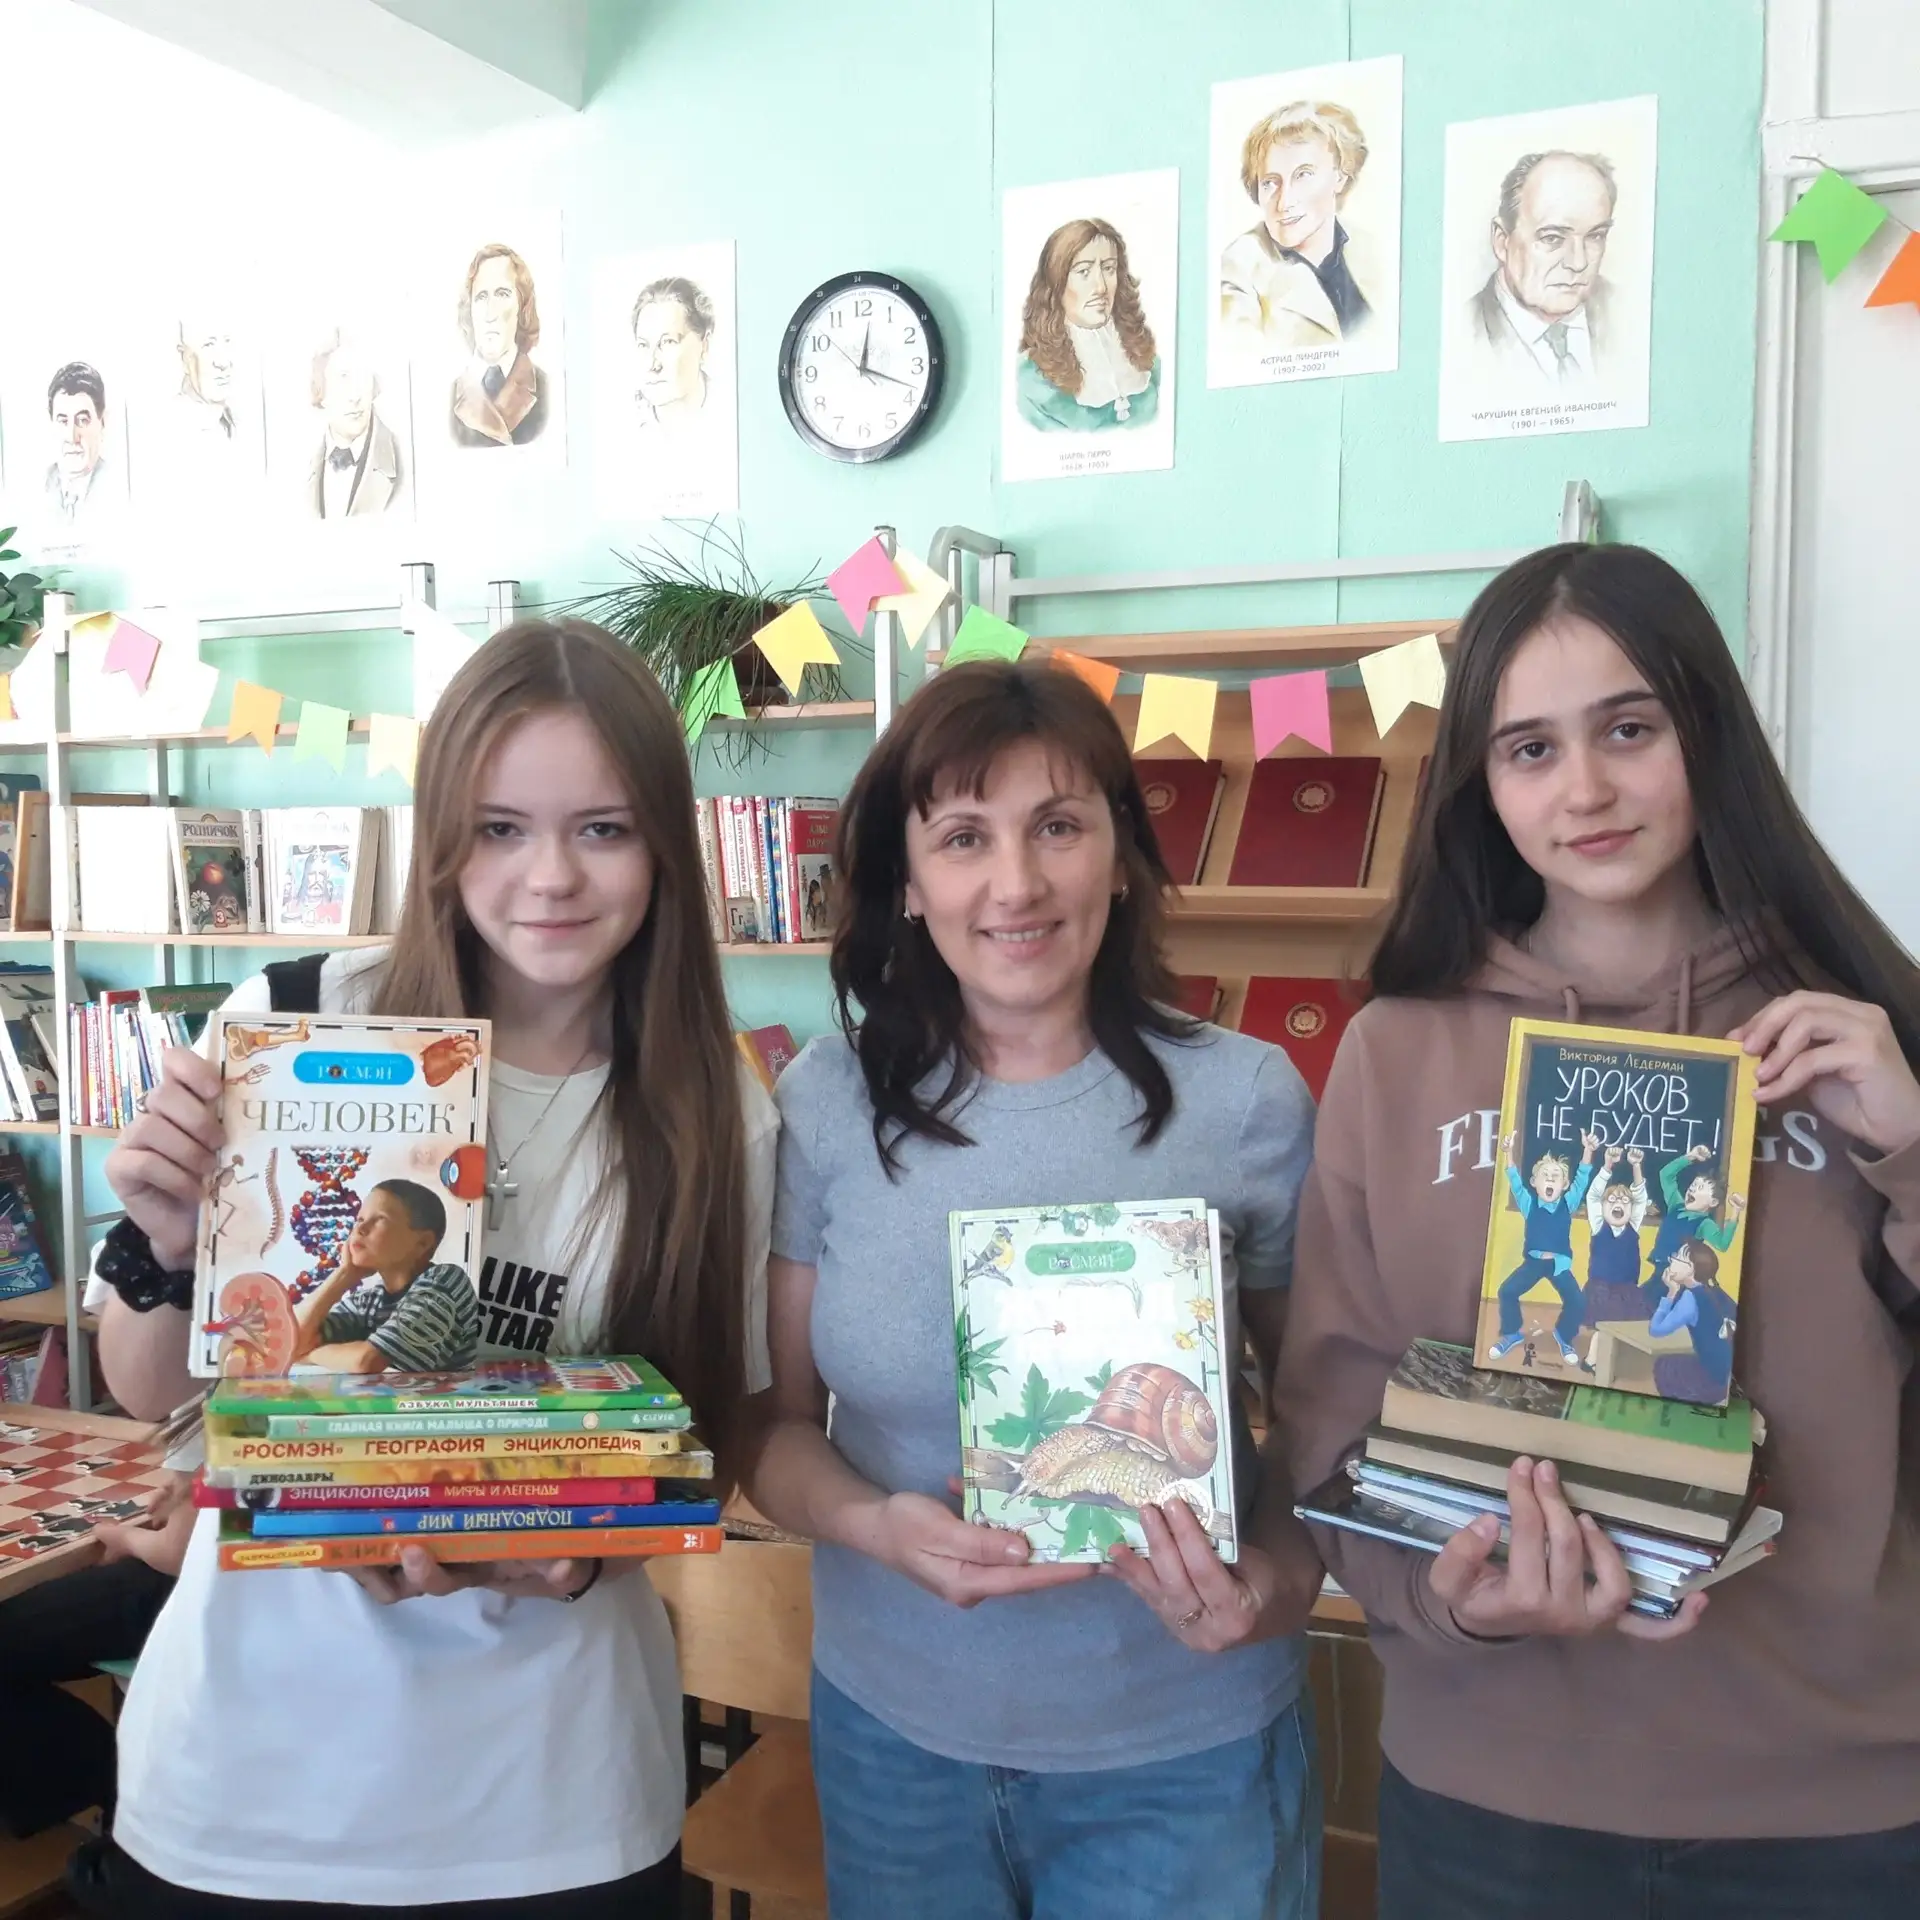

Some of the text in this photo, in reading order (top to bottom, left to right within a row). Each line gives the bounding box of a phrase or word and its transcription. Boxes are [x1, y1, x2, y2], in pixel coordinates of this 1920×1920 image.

[853, 299, 874, 318] 12
[886, 305, 893, 323] 1
[829, 310, 844, 329] 11
[811, 333, 831, 353] 10
[903, 327, 917, 345] 2
[911, 356, 925, 375] 3
[1260, 350, 1340, 365] АСТРИД ЛИНДГРЕН
[804, 365, 818, 384] 9
[813, 395, 827, 413] 8
[902, 389, 916, 407] 4
[1471, 401, 1617, 420] ЧАРУШИН ЕВГЕНИЙ ИВАНОВИЧ
[832, 415, 845, 433] 7
[884, 412, 898, 430] 5
[858, 423, 871, 439] 6
[182, 823, 239, 838] РОДНИЧОК
[216, 910, 225, 923] 3
[1554, 1066, 1690, 1116] УРОКОВ
[241, 1100, 456, 1135] ЧЕЛОВЕК
[1536, 1103, 1574, 1142] НЕ
[478, 1255, 569, 1318] LIKE
[398, 1399, 538, 1409] АЗБУКА МУЛЬТЯШЕК
[328, 1416, 549, 1433] ГЛАВНАЯ КНИГА МАЛЫША О ПРИРОДЕ
[233, 1435, 642, 1459] «РОСМЭН» ГЕОГРАФИЯ ЭНЦИКЛОПЕДИЯ
[250, 1472, 335, 1486] ДИНОЗАВРЫ
[289, 1483, 560, 1500] ЭНЦИКЛОПЕДИЯ МИФЫ И ЛЕГЕНДЫ
[416, 1509, 573, 1530] ПОДВОДНЫЙ МИР
